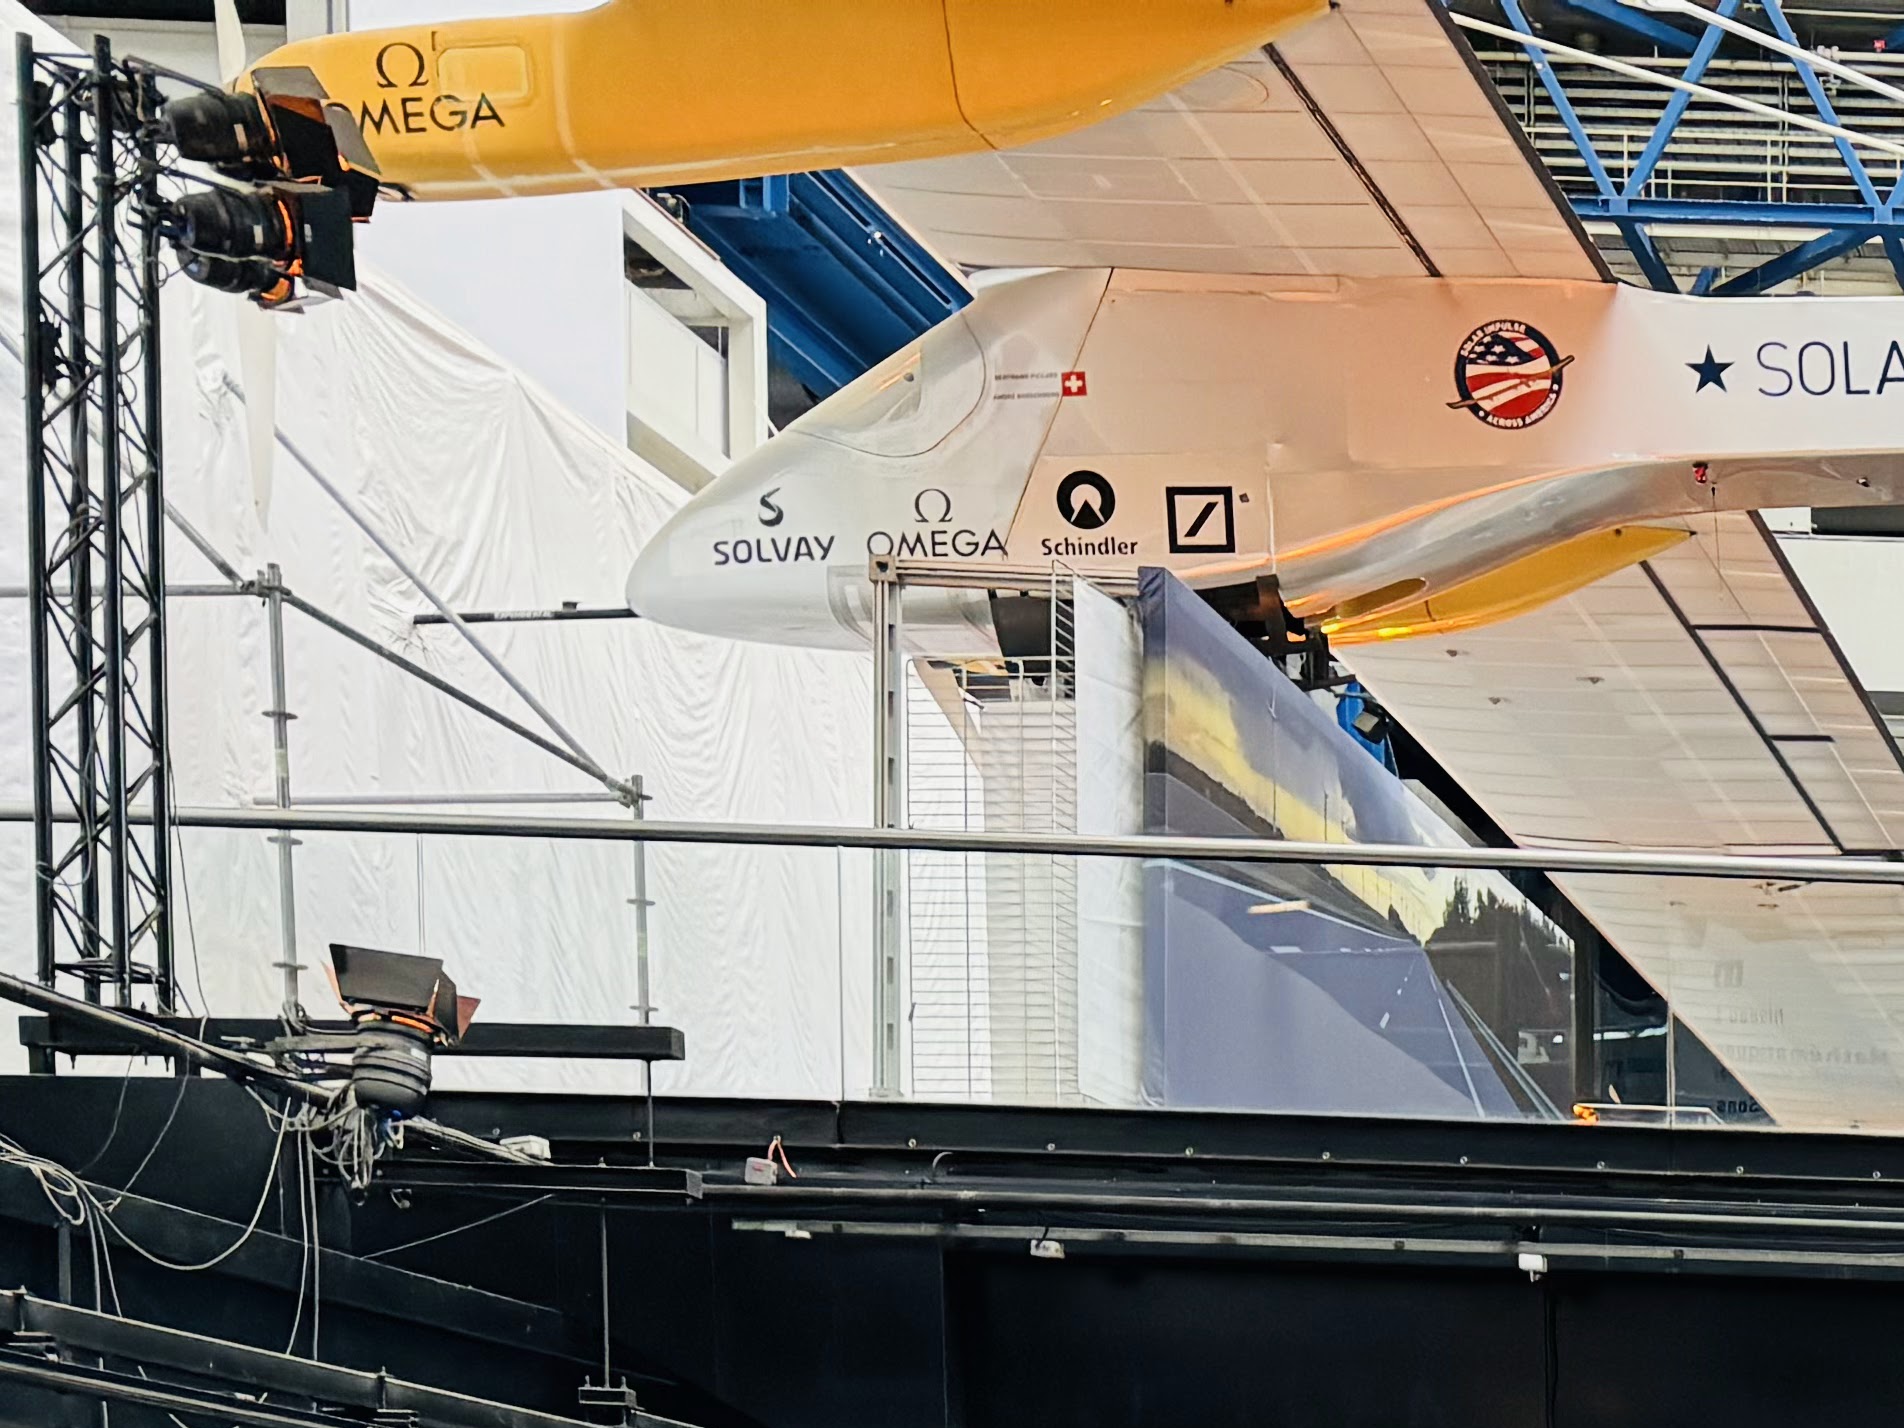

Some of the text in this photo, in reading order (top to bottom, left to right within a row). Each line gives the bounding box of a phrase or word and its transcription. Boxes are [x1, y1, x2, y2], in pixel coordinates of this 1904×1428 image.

[326, 92, 506, 135] MEGA
[713, 534, 836, 566] SOLVAY
[866, 529, 1008, 558] OMEGA
[1041, 536, 1139, 557] Schindler
